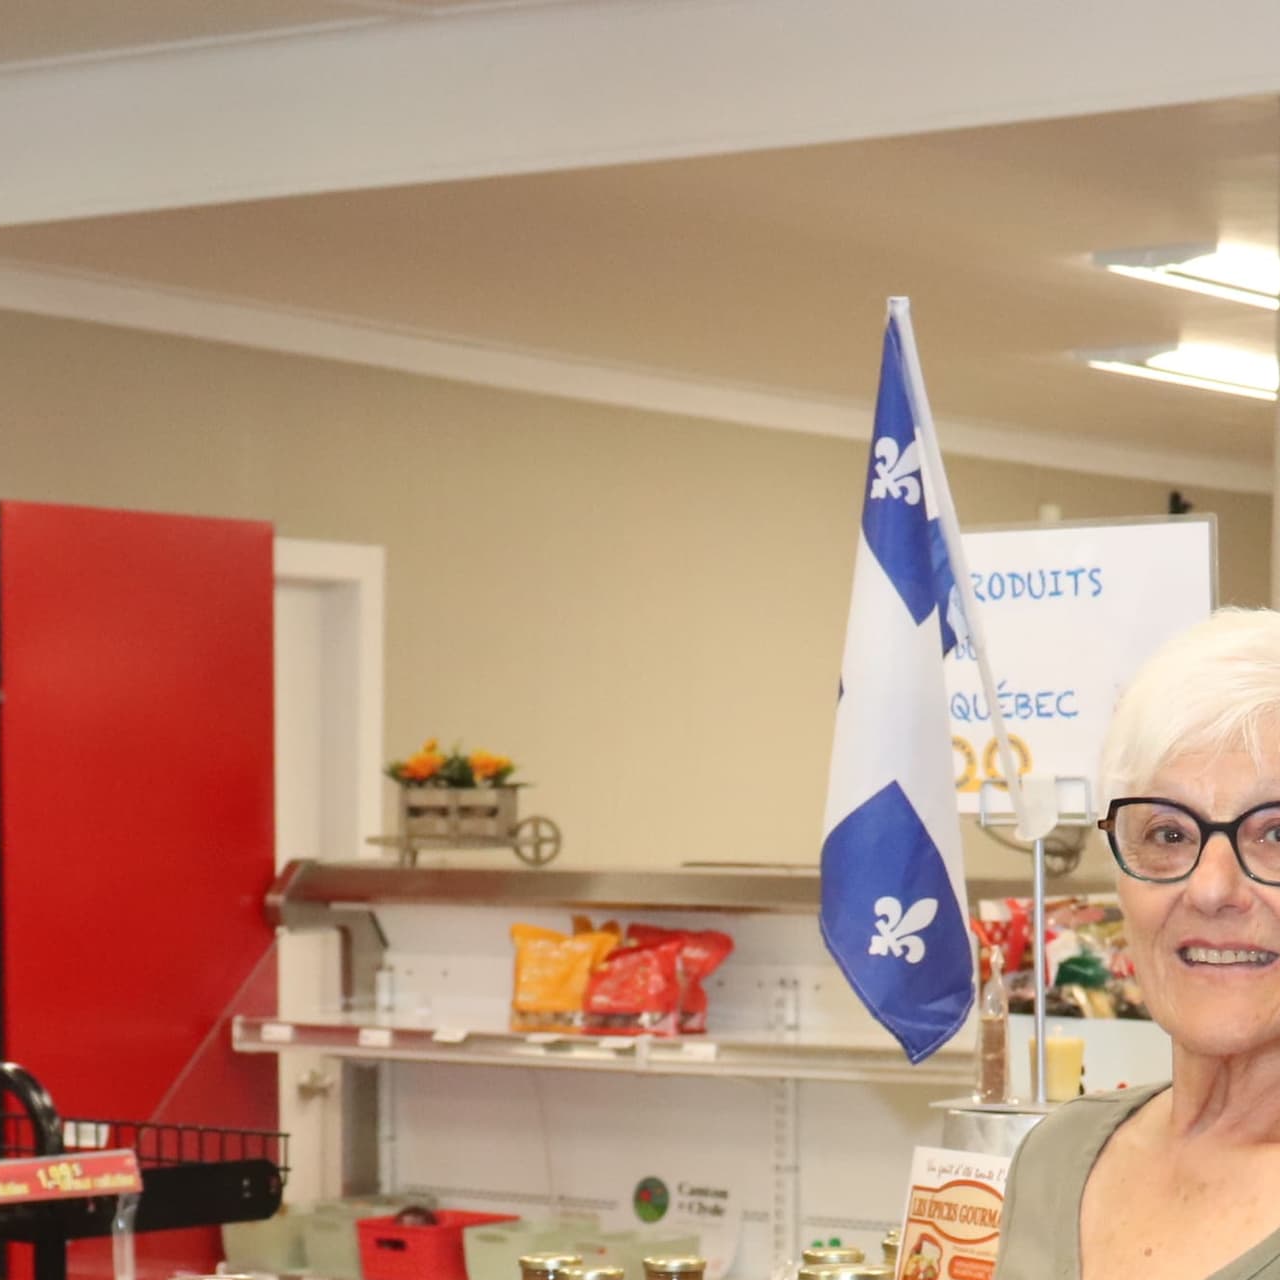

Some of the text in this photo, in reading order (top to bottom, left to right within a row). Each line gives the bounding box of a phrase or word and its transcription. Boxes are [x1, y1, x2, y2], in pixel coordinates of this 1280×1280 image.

[970, 568, 1103, 602] RODUITS
[951, 680, 1079, 723] QUÉBEC
[958, 1203, 1002, 1229] GOURM
